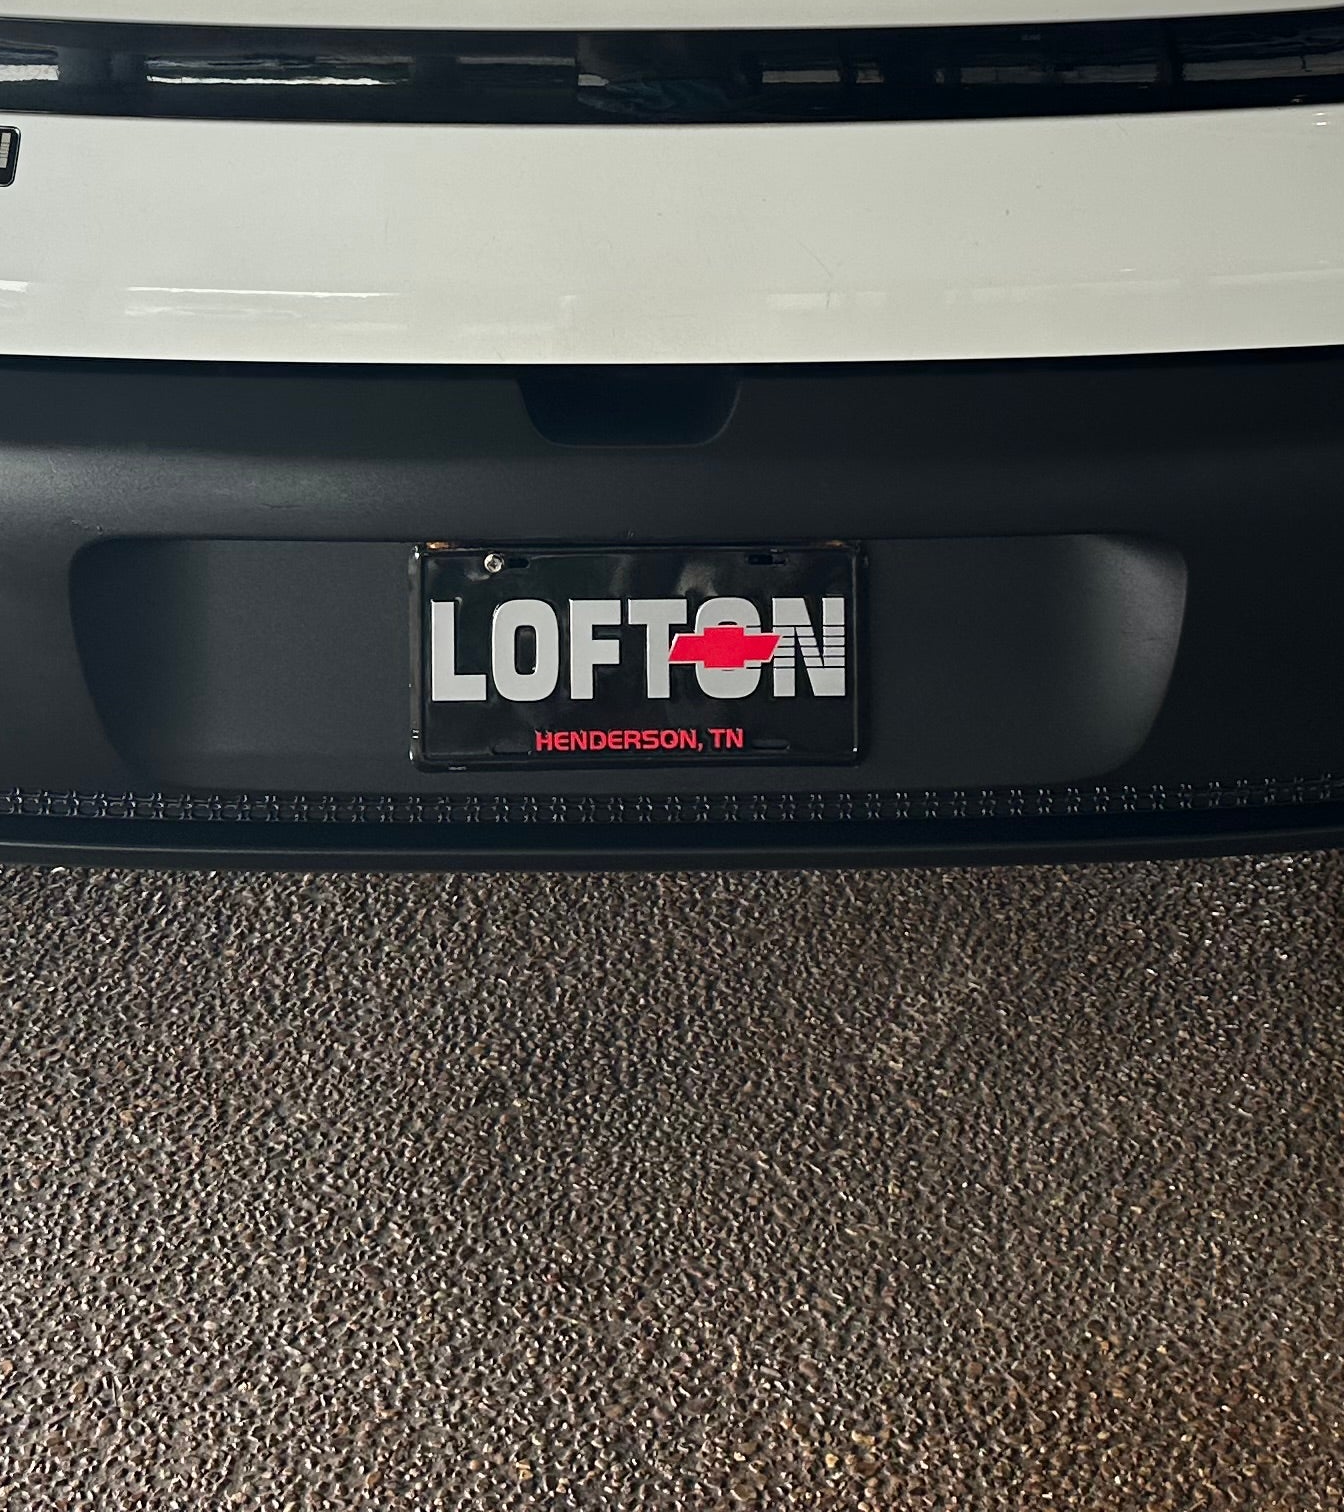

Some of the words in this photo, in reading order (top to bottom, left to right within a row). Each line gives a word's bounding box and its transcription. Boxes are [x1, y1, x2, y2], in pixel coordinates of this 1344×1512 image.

[430, 597, 847, 702] LOFTON
[534, 729, 704, 753] HENDERSON,
[708, 727, 744, 748] TN
